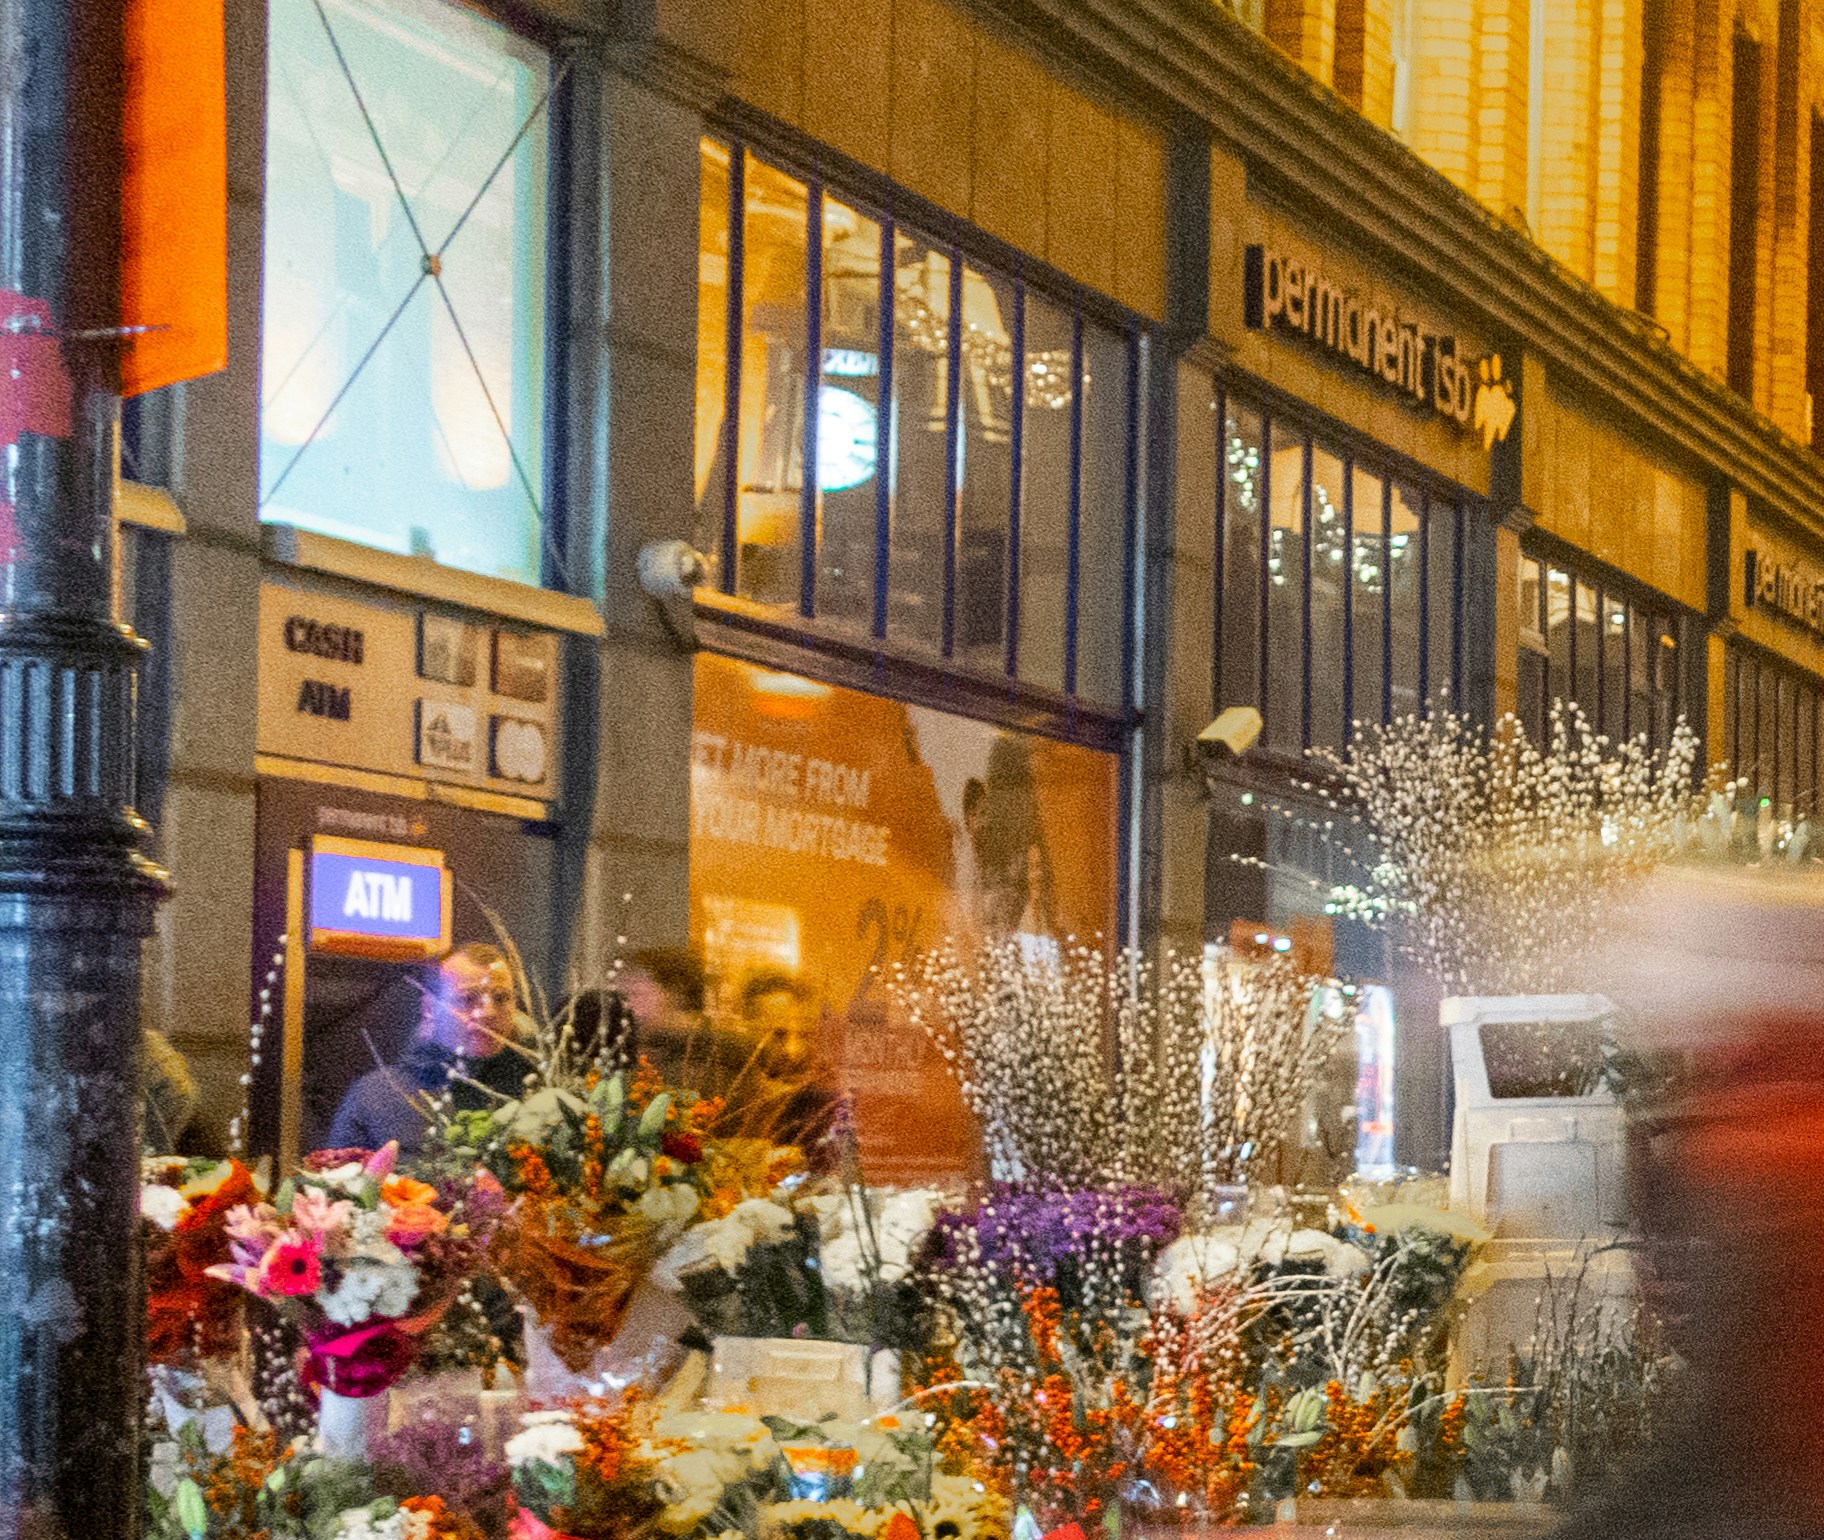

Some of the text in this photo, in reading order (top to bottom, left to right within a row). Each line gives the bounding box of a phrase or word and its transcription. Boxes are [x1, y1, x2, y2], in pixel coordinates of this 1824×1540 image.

[1261, 250, 1471, 422] permanent tsb
[283, 614, 364, 665] CASH
[297, 679, 351, 722] ATM
[693, 731, 871, 809] ET MORE FROM
[764, 804, 891, 867] MORTGAGE
[342, 869, 413, 923] ATM
